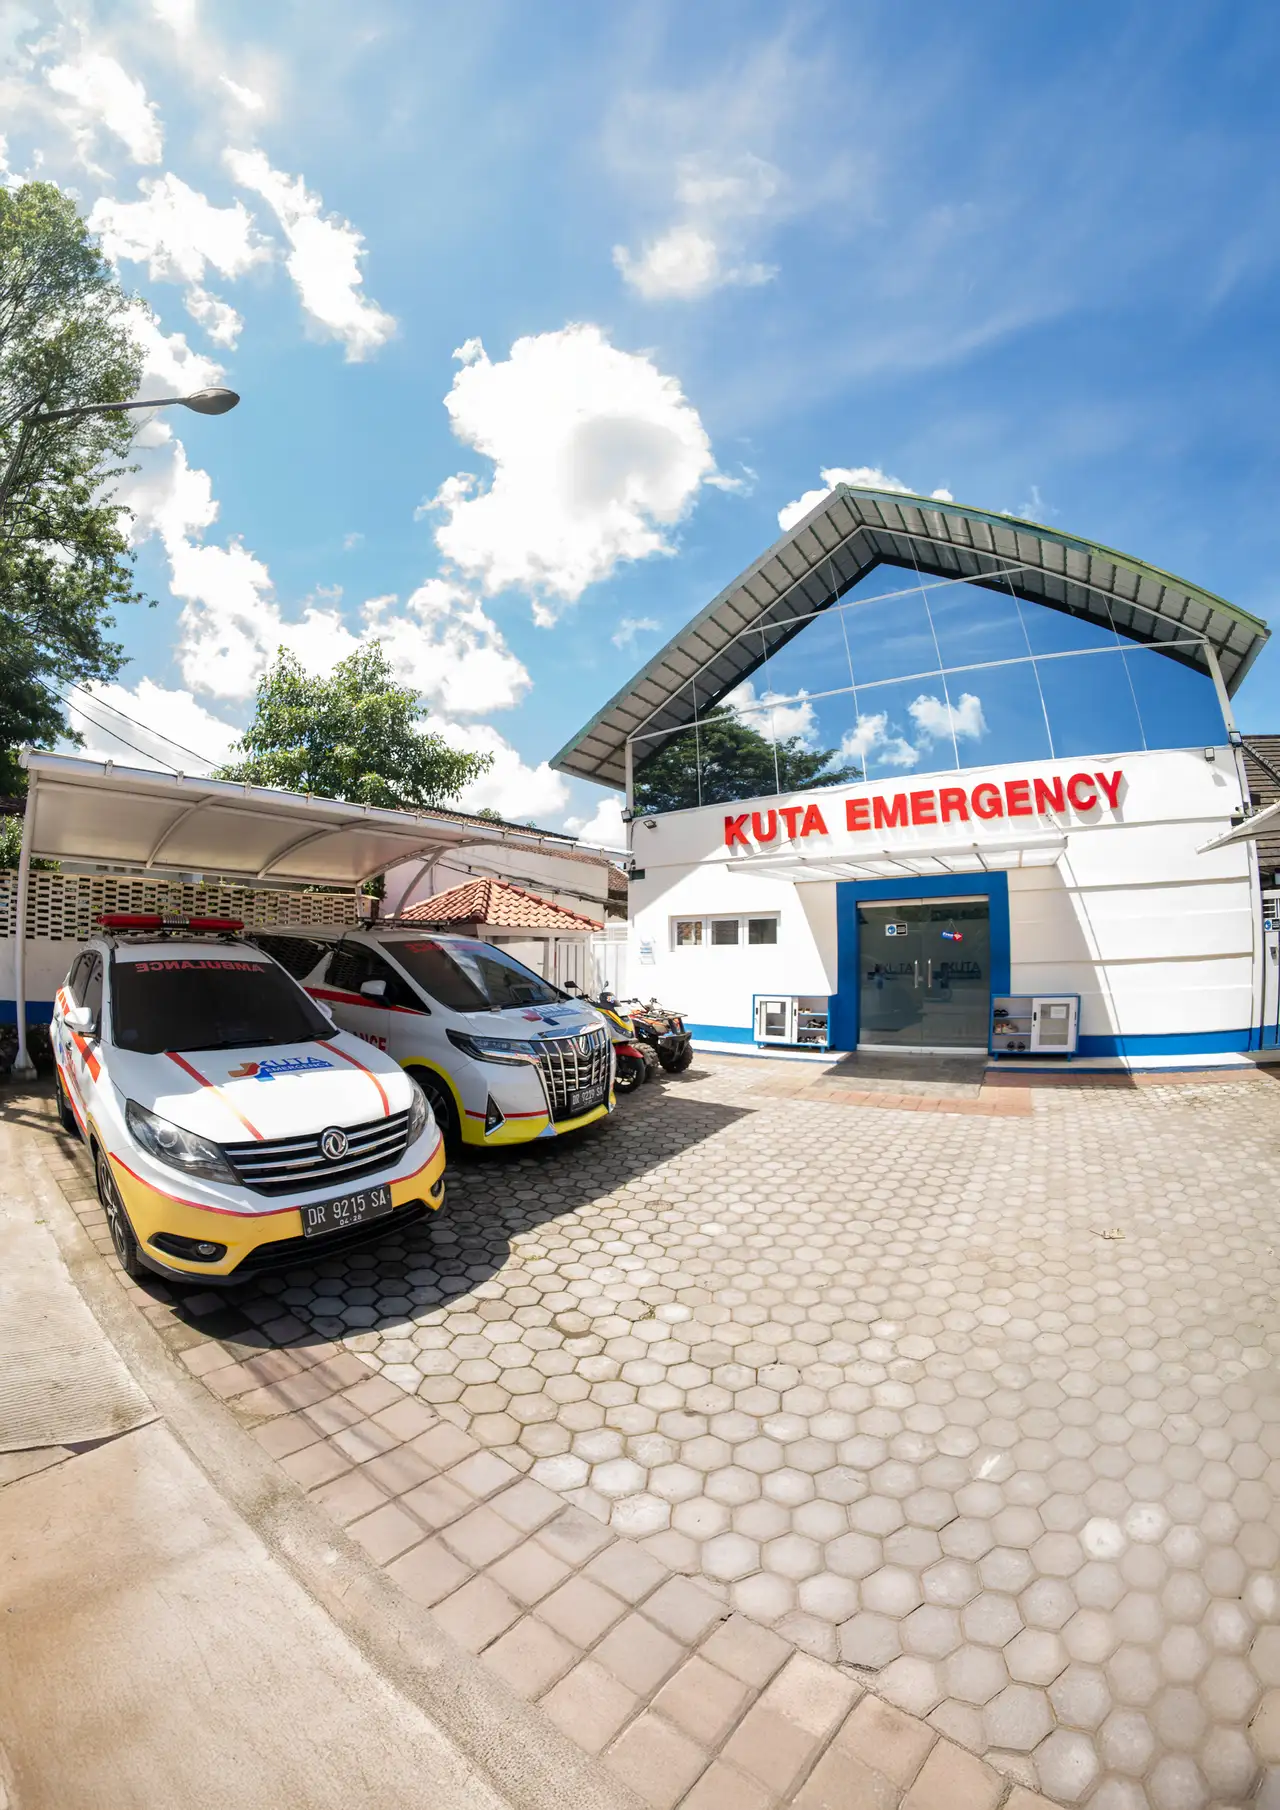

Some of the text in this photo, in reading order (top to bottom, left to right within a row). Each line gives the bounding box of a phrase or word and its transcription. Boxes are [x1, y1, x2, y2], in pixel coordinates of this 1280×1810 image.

[724, 770, 1123, 846] KUTA EMERGENCY
[949, 961, 981, 973] KUTA
[259, 1057, 333, 1067] KUTA
[264, 1062, 330, 1073] EMERGENCY
[308, 1189, 387, 1226] DR 9215 SA
